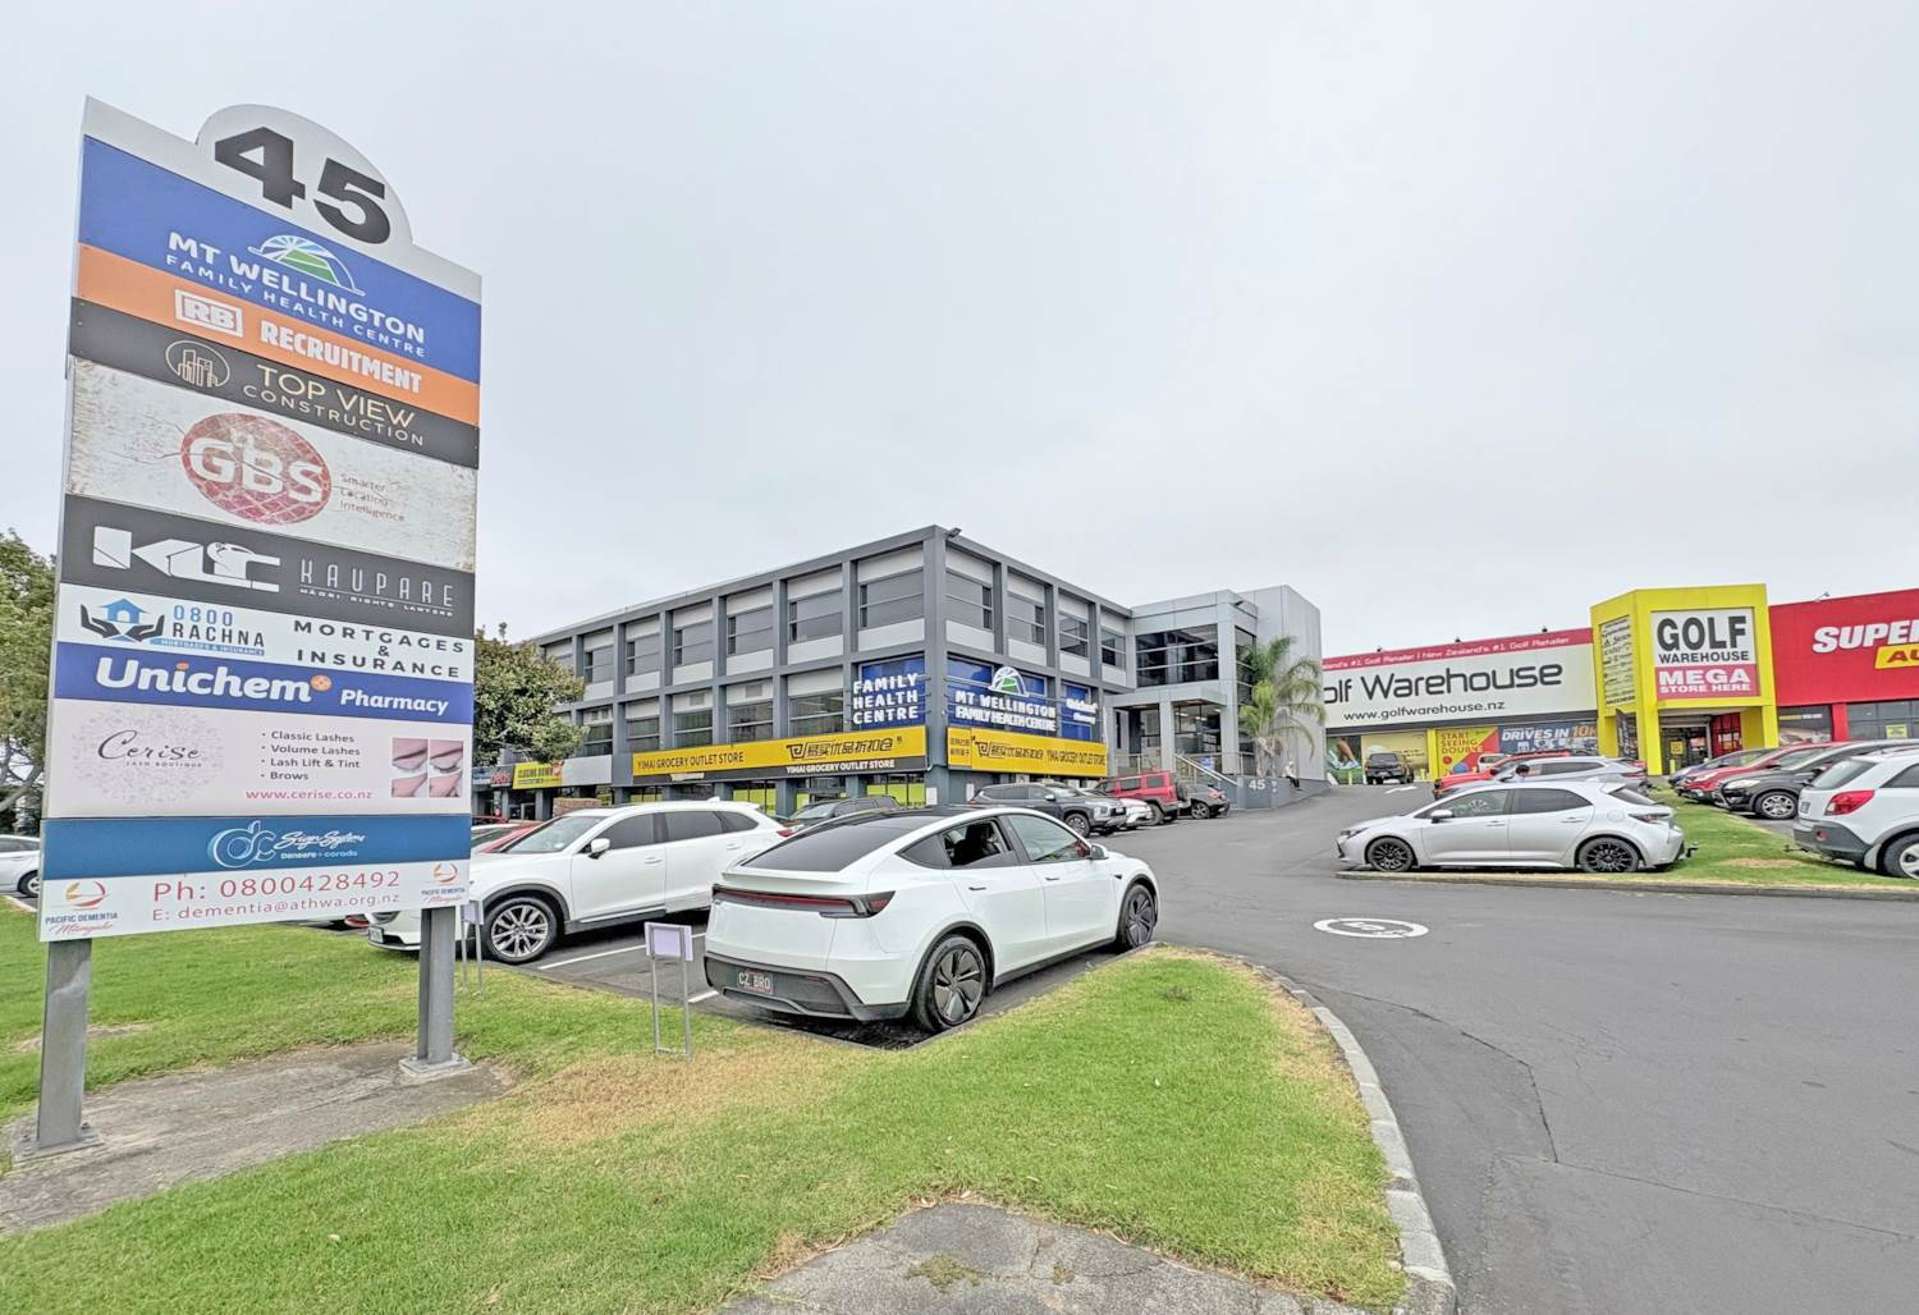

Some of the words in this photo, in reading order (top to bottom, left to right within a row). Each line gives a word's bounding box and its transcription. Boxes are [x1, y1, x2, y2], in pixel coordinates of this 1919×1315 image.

[214, 126, 391, 244] 45
[169, 231, 220, 265] MT
[229, 254, 425, 343] WELLINGTON
[166, 254, 253, 293] FAMILY
[263, 290, 344, 328] HEALTH
[353, 323, 425, 358] CENTRE
[183, 298, 235, 330] RB
[260, 319, 422, 394] RECRUITMENT
[257, 363, 326, 400] TOP
[336, 388, 415, 429] VIEW
[243, 384, 424, 447] CONSTRUCTION
[189, 433, 323, 503] GBS
[300, 558, 453, 607] KAUPARE
[173, 604, 233, 627] 0800
[172, 622, 265, 648] RACHNA
[294, 620, 464, 653] MORTGAGES
[1657, 615, 1747, 651] GOLF
[378, 645, 389, 657] &
[1658, 651, 1749, 664] WAREHOUSE
[297, 649, 459, 678] INSURANCE
[96, 656, 311, 702] Unichem
[341, 689, 449, 717] Pharmacy
[853, 672, 919, 694] FAMILY
[1323, 678, 1352, 704] olf
[1360, 663, 1563, 701] Warehouse
[1659, 668, 1750, 686] MEGA
[1659, 685, 1708, 693] STORE
[1711, 683, 1751, 692] HERE
[853, 690, 918, 709] HEALTH
[955, 690, 975, 705] MT
[979, 694, 1056, 718] WELLINGTON
[1343, 700, 1506, 721] www.golfwarehouse.nz
[853, 705, 919, 725] CENTRE
[97, 729, 201, 760] Cerise
[271, 731, 313, 741] Classic
[315, 732, 355, 743] Lashes
[1502, 728, 1553, 741] DRIVES
[1554, 728, 1570, 739] IN
[270, 744, 318, 754] Volume
[321, 746, 361, 756] Lashes
[657, 757, 688, 768] GROCERY
[690, 754, 718, 766] OUTLET
[719, 751, 744, 763] STORE
[270, 758, 298, 767] Lash
[302, 758, 321, 768] Lift
[324, 759, 334, 768] &
[338, 759, 361, 768] Tint
[840, 760, 868, 770] OUTLET
[868, 759, 895, 769] STORE
[270, 771, 309, 780] Brows
[1248, 779, 1265, 790] 45
[246, 788, 373, 800] www.cerise.co.nz
[153, 881, 206, 902] Ph:
[220, 871, 399, 898] 0800428492
[152, 908, 169, 922] E:
[178, 893, 399, 920] dementia@athwa.org.nz
